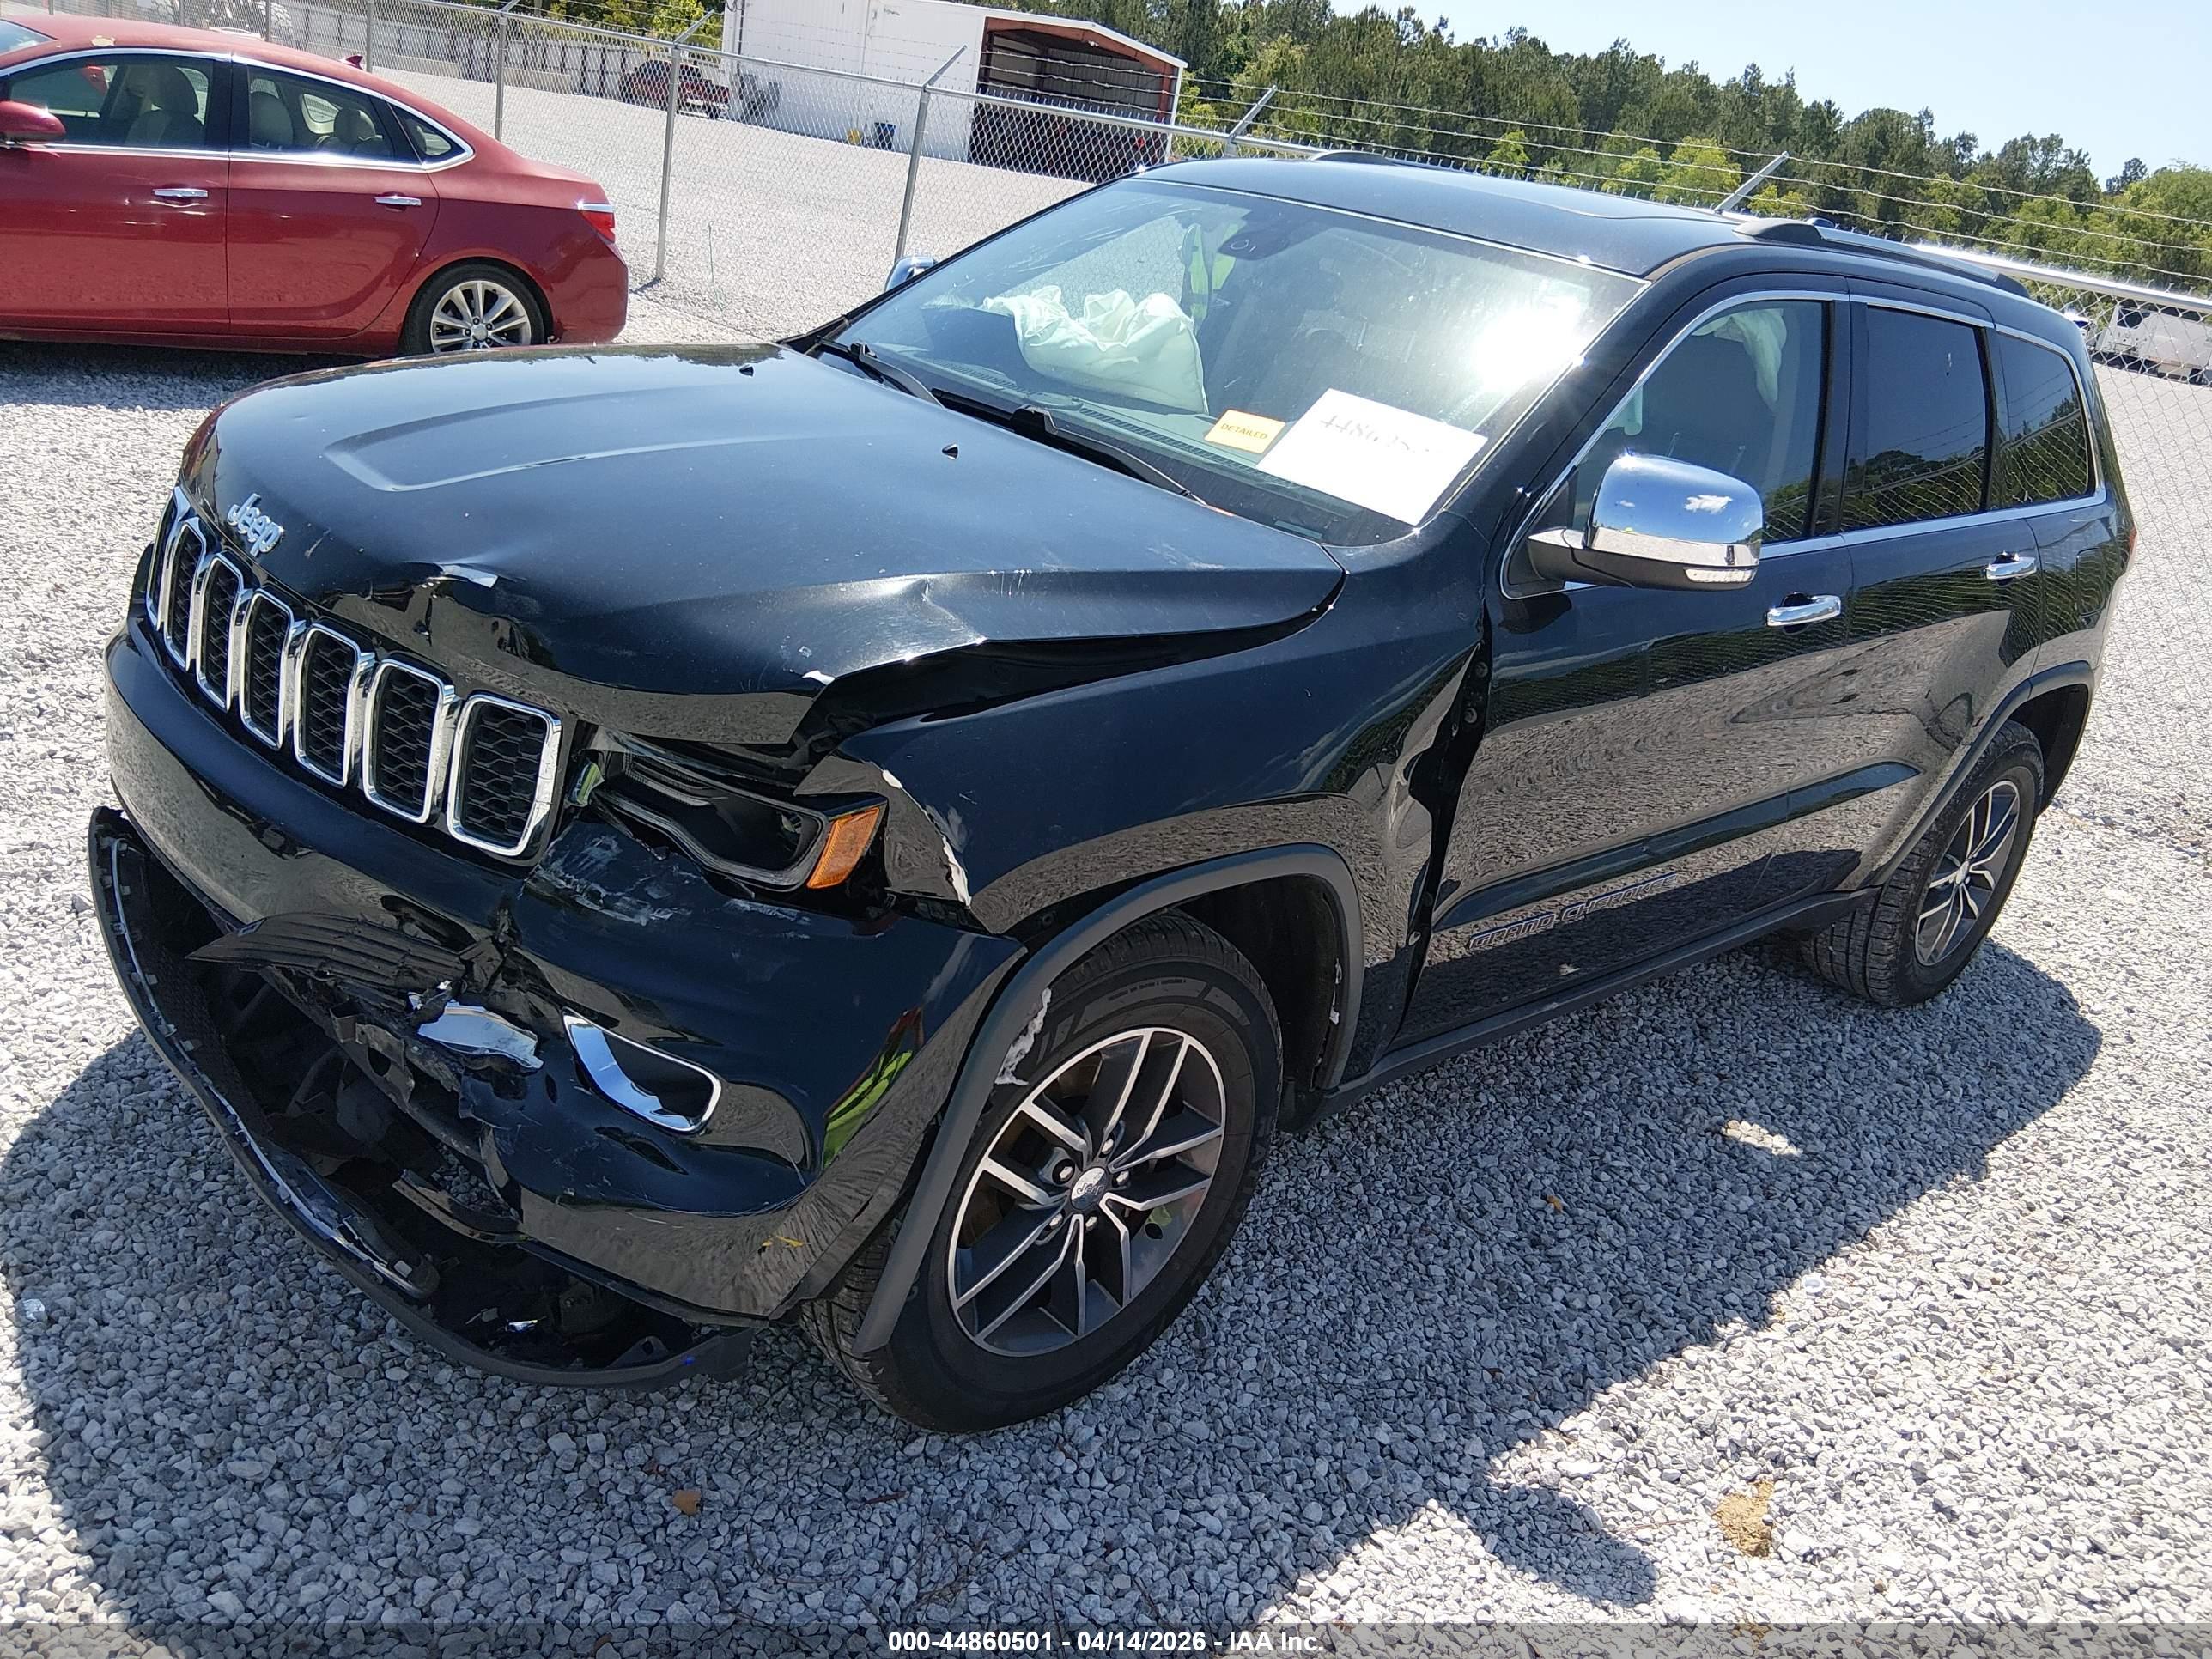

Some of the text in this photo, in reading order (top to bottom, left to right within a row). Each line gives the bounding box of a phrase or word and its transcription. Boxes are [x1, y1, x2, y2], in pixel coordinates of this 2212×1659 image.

[1220, 422, 1268, 440] DETAILED
[228, 493, 285, 557] Jeep
[1469, 873, 1676, 949] GRAND CHEROKEE
[1077, 1182, 1104, 1195] Jeep
